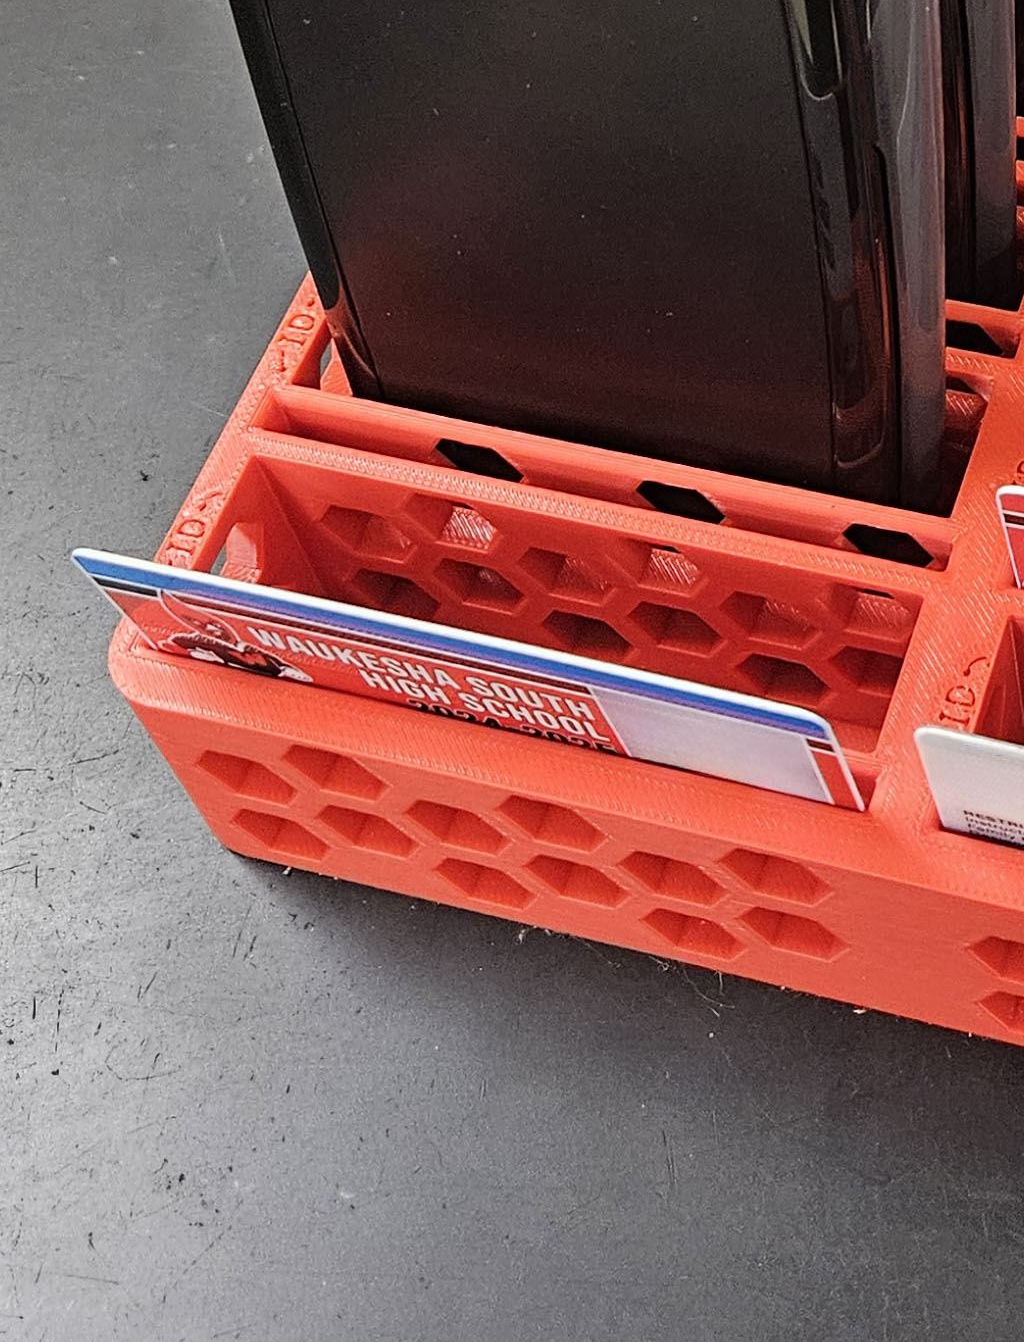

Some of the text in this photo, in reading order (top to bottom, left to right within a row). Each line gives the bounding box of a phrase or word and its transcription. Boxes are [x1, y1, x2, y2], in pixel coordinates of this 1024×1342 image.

[246, 625, 596, 721] WAUKESHA SOUTH
[358, 669, 610, 743] HIGH SCHOOL
